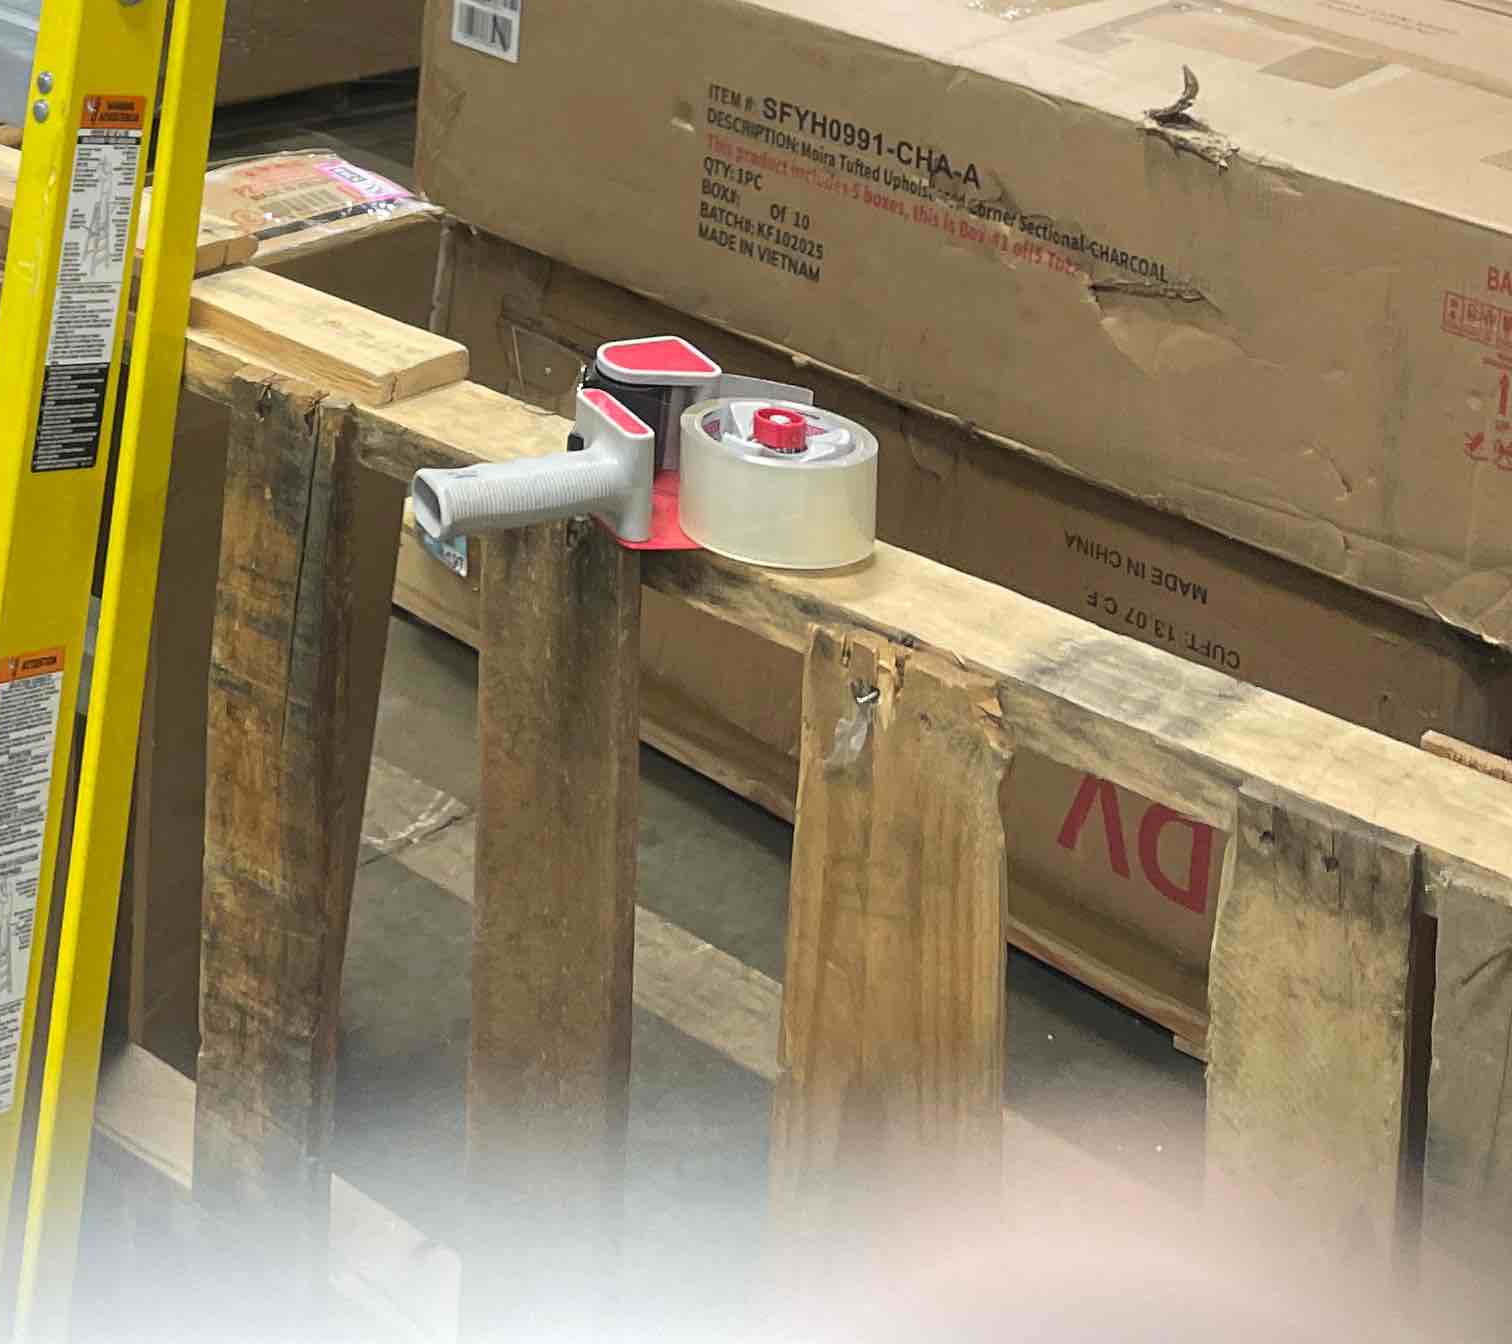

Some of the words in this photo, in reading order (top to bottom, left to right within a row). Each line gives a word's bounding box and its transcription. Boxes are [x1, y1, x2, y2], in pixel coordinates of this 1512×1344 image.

[708, 82, 742, 108] ITEM
[762, 97, 981, 190] SFYH0991-CHA-A
[703, 155, 735, 179] QTY:
[840, 153, 881, 183] Tufted
[794, 211, 811, 231] 10
[698, 222, 737, 252] MADE
[739, 237, 754, 257] IN
[757, 243, 821, 283] VIETNAM
[1063, 531, 1122, 570] CHINA
[1126, 557, 1147, 580] IN
[1150, 567, 1208, 605] MADE
